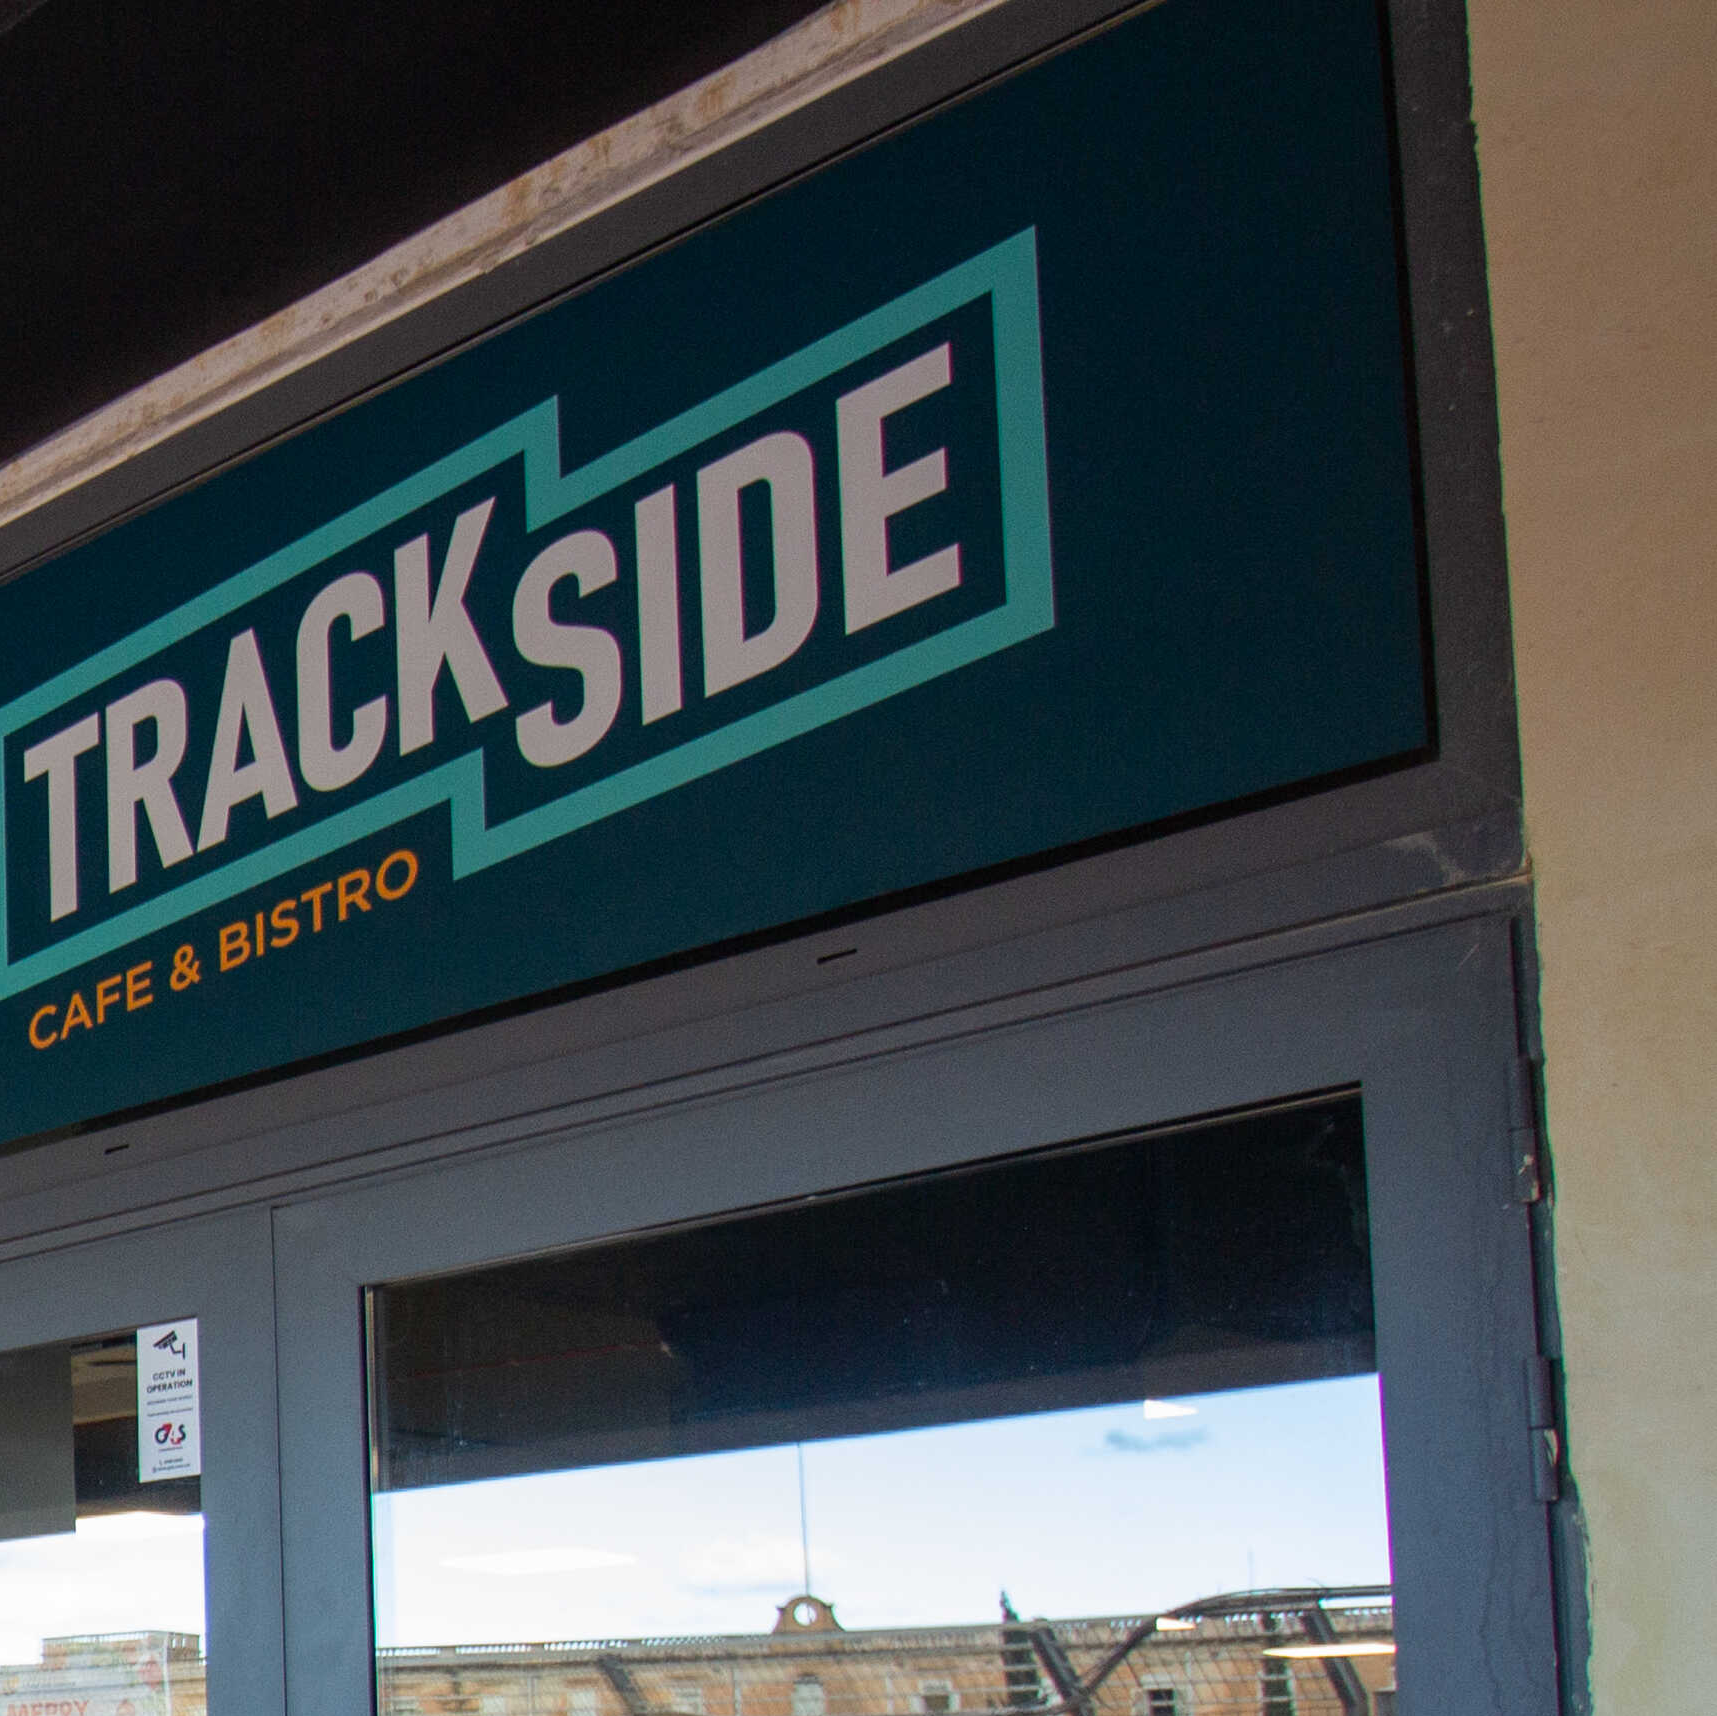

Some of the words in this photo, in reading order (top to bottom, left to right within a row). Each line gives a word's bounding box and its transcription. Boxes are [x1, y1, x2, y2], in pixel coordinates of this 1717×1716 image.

[22, 341, 961, 921] TRACKSIDE
[27, 961, 154, 1050] CAFE
[168, 946, 202, 993] &
[217, 849, 419, 971] BISTRO
[146, 1378, 193, 1394] OPERATION
[152, 1369, 175, 1381] CCTV
[176, 1367, 186, 1377] IN
